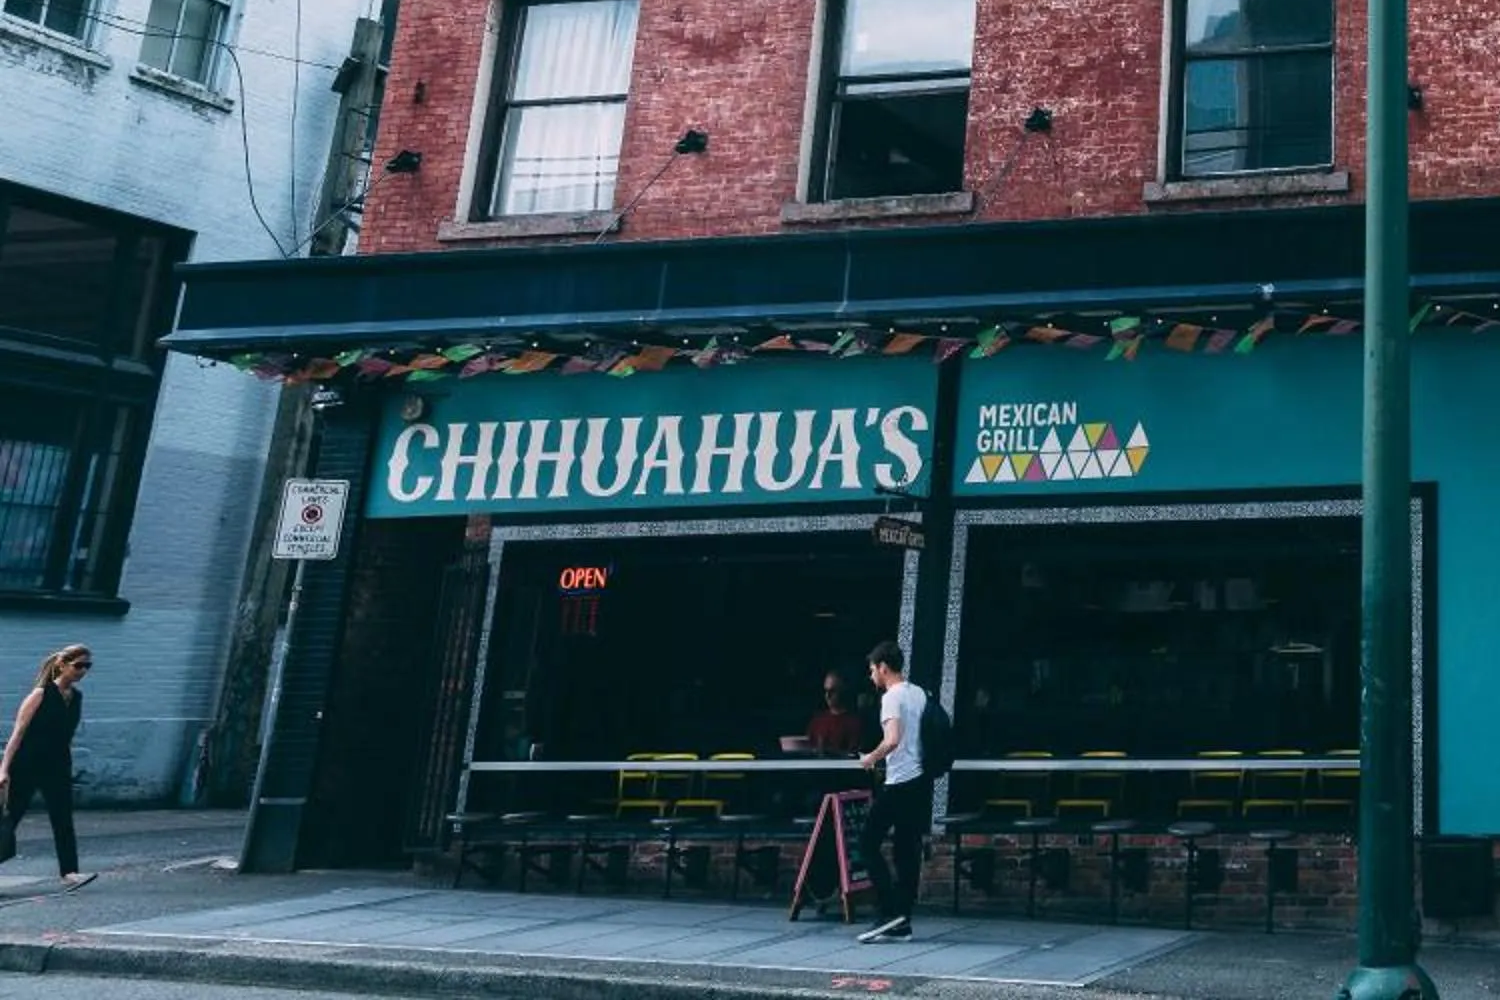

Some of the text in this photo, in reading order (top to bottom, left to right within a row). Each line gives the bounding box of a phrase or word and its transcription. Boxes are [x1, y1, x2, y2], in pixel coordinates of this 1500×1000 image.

[979, 402, 1077, 427] MEXICAN
[976, 428, 1039, 453] GRILL
[388, 405, 928, 502] CHIHUAHUA'S
[560, 567, 607, 589] OPEN
